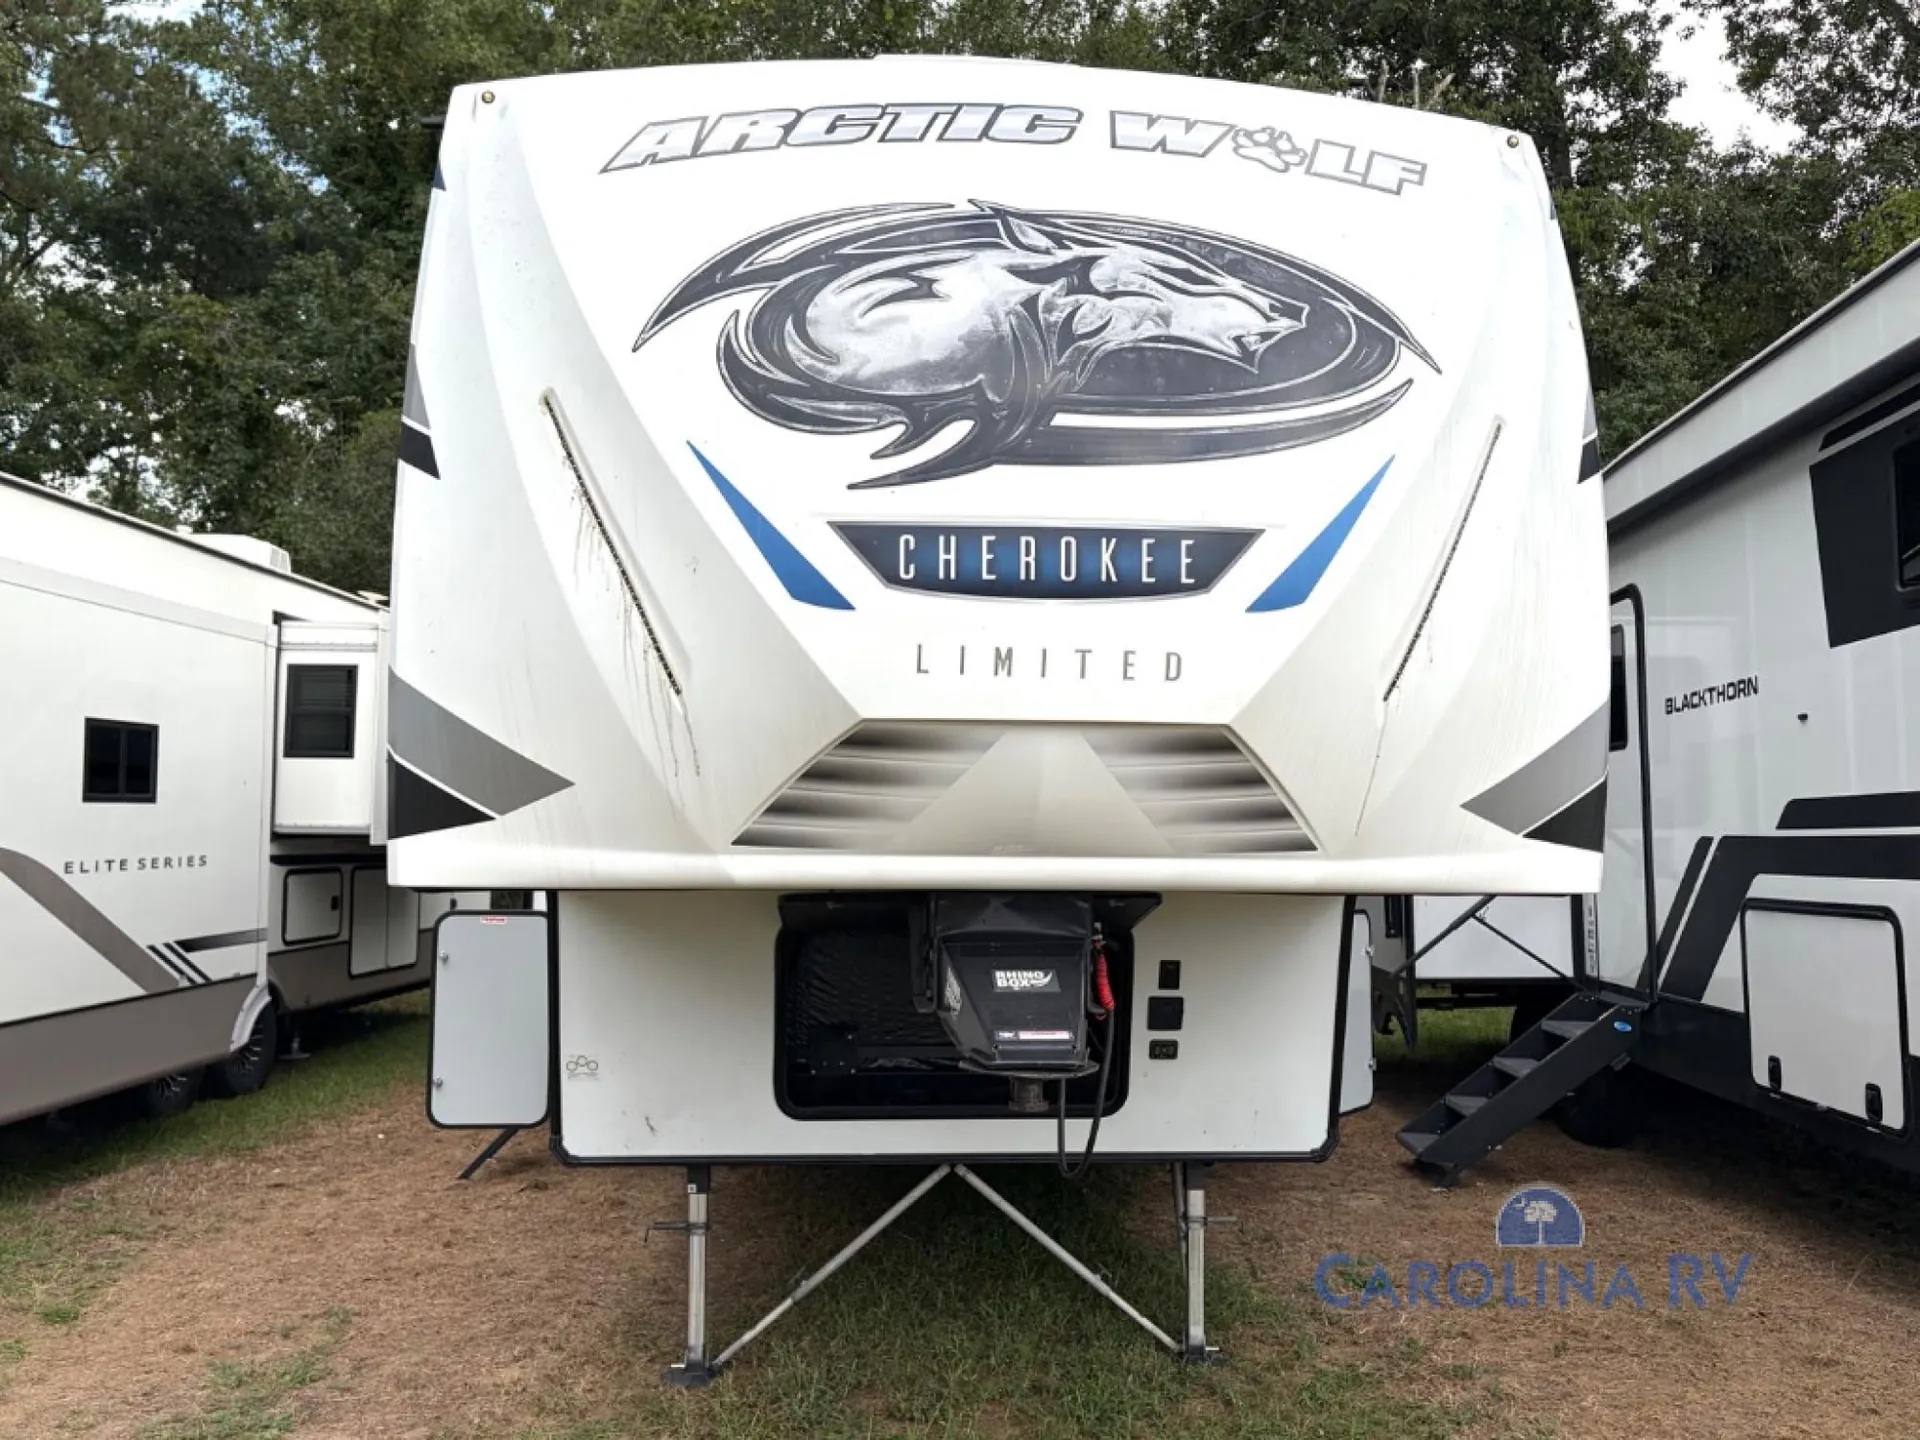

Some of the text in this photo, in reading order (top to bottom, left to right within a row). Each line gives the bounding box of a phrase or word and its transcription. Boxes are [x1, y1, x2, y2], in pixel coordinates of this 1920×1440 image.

[598, 103, 1084, 174] ARCTIC
[899, 534, 1195, 584] CHEROKEE
[916, 644, 1183, 681] LIMITED
[1664, 675, 1759, 716] BLACKTHORN
[63, 854, 208, 875] ELITE SERIES
[994, 970, 1044, 980] RHINO
